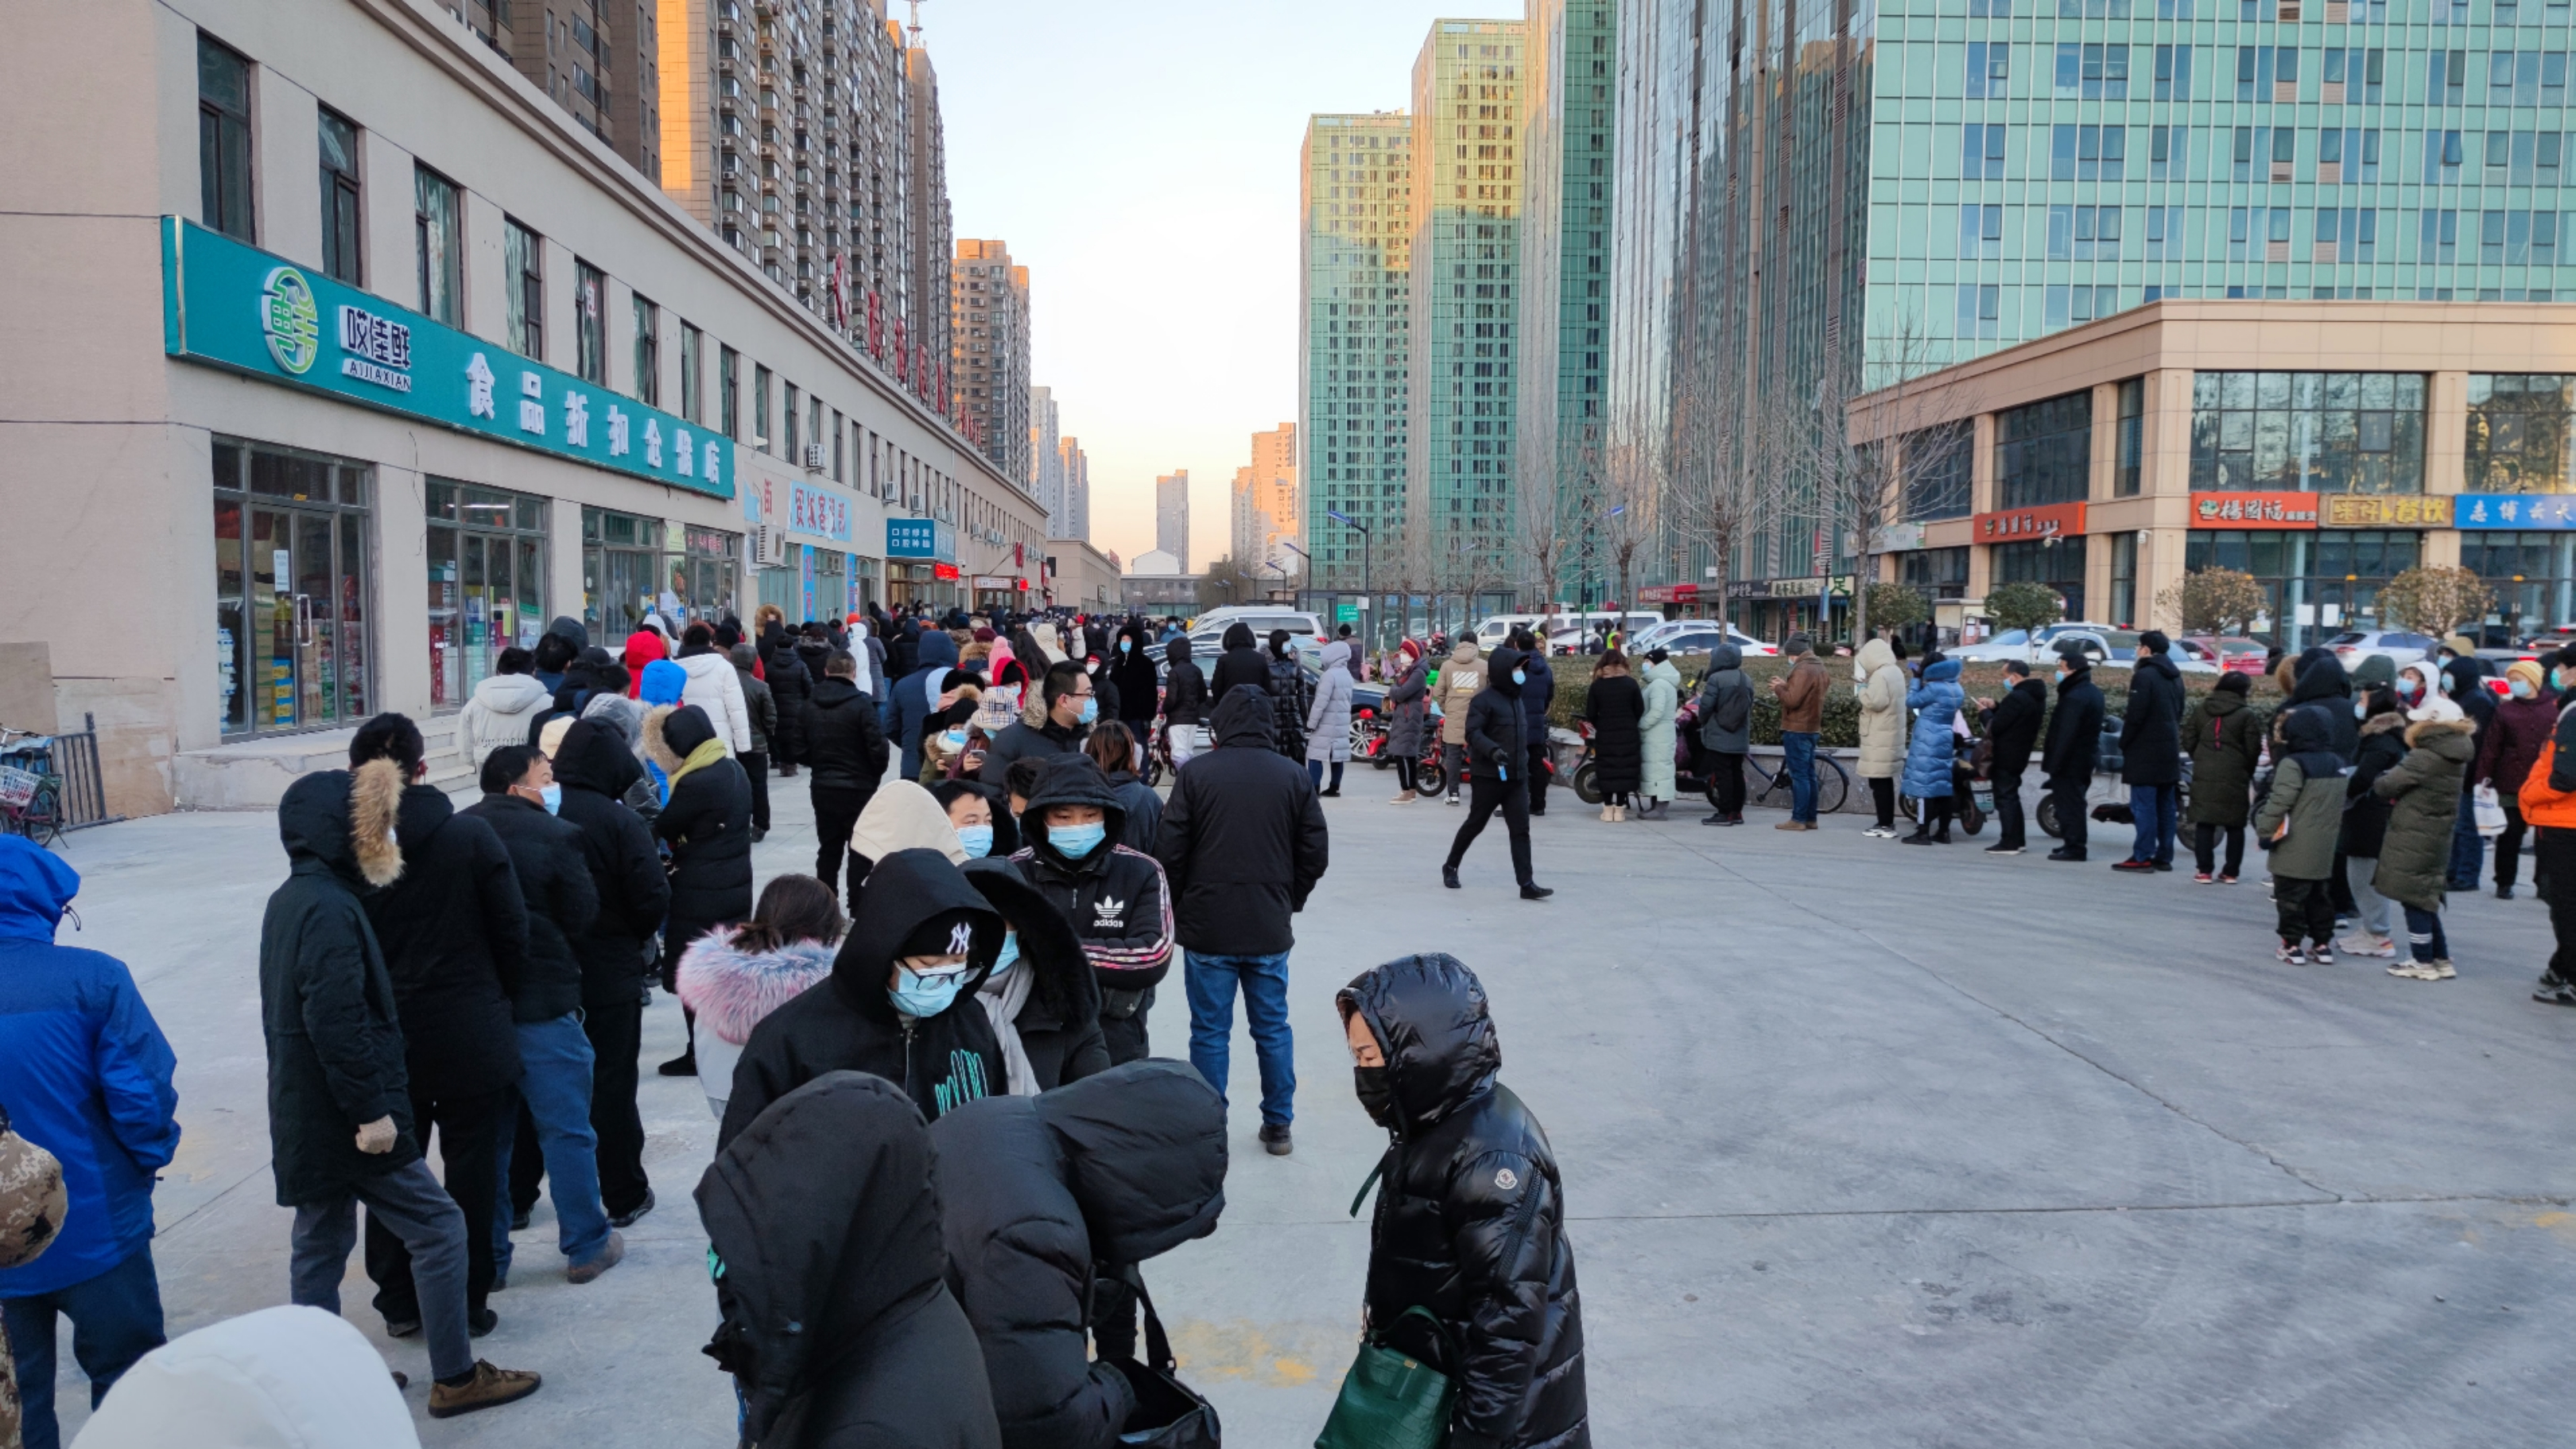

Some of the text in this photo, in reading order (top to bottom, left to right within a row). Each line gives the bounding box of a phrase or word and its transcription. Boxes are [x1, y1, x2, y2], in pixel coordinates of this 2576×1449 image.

[349, 360, 411, 391] AIJIAXIAN
[466, 352, 720, 485] 食品折扣仓储店
[1092, 918, 1124, 928] adidas
